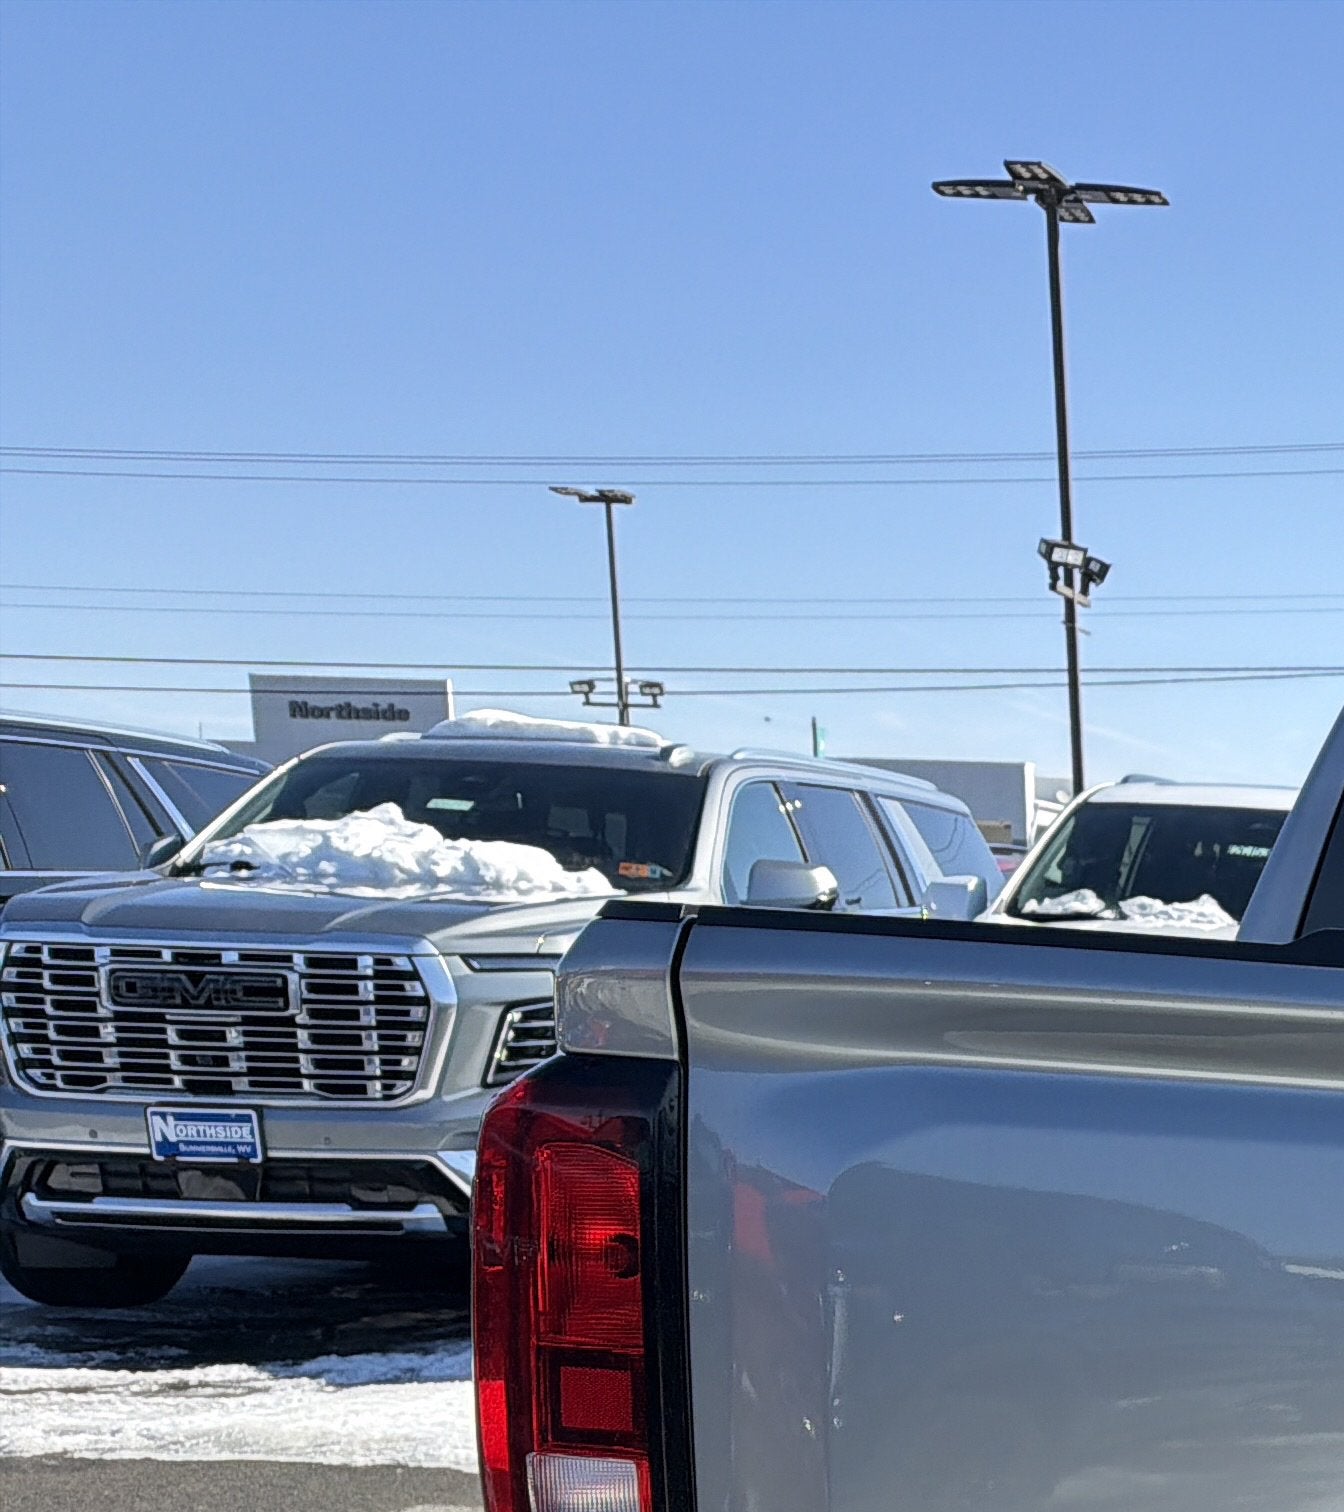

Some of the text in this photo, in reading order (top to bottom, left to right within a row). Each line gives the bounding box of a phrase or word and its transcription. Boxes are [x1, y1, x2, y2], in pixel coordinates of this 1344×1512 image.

[288, 700, 410, 721] Northside
[111, 971, 284, 1009] GMC
[151, 1115, 252, 1142] NORTHSIDE
